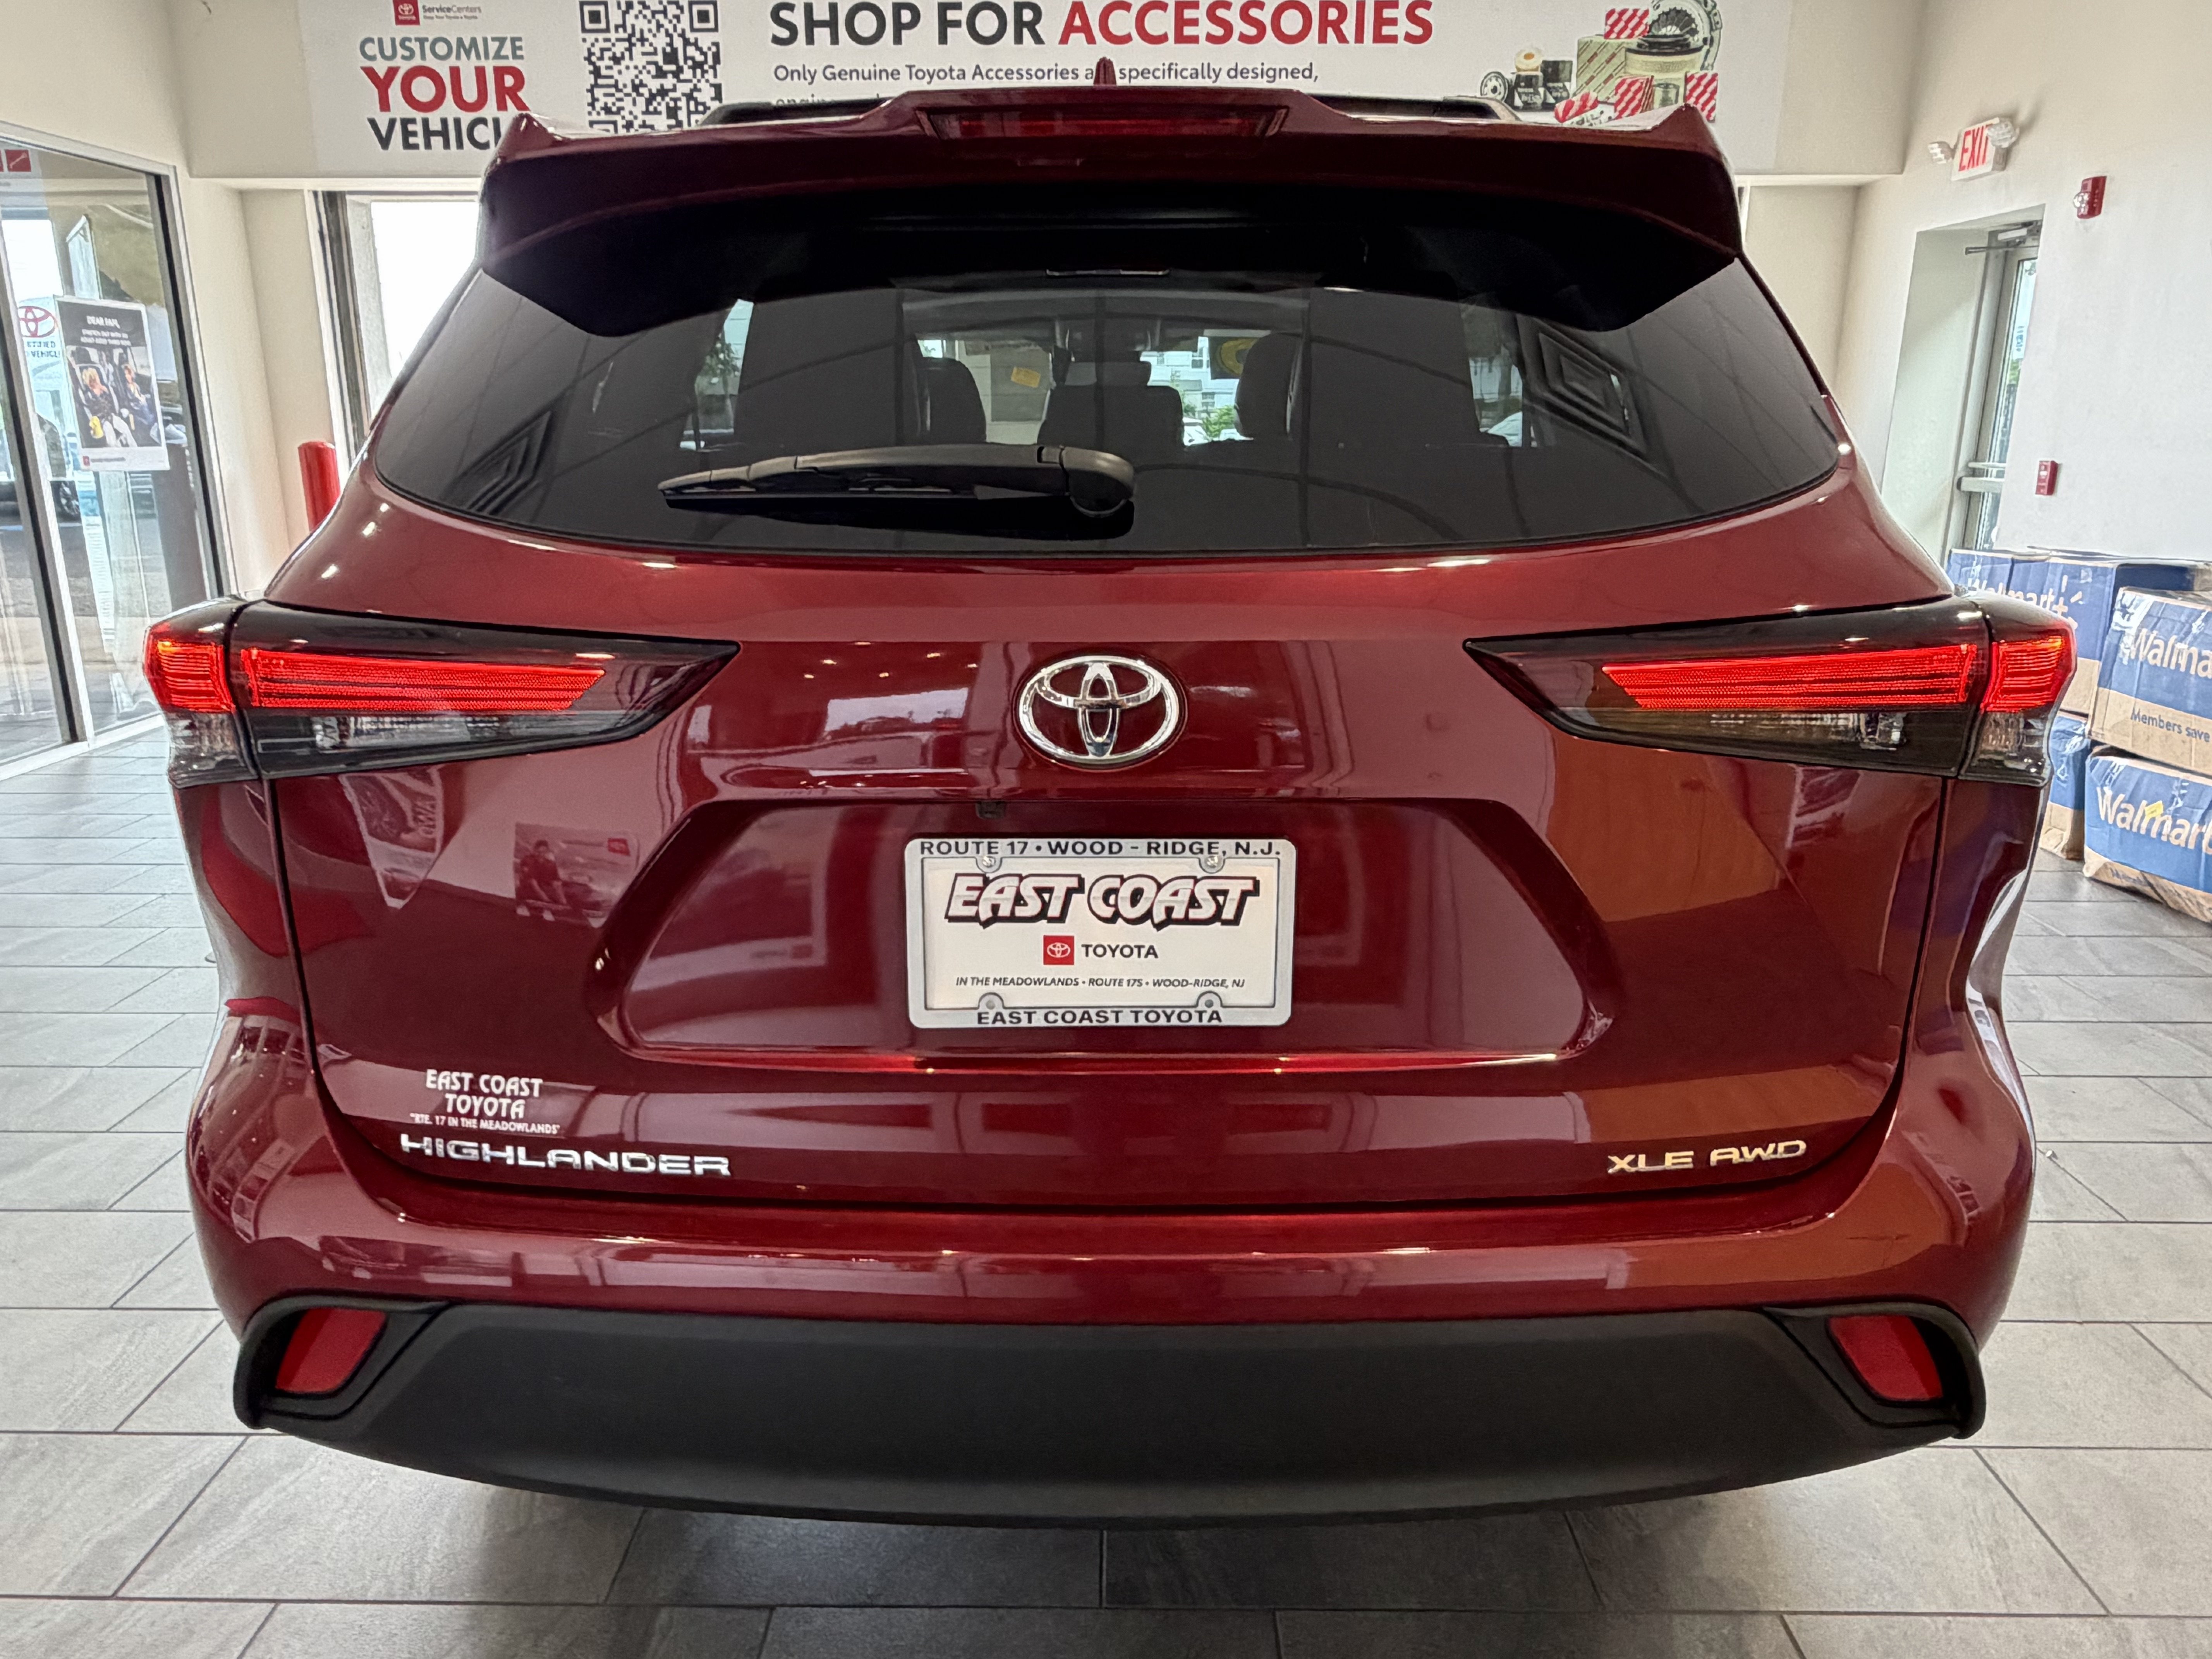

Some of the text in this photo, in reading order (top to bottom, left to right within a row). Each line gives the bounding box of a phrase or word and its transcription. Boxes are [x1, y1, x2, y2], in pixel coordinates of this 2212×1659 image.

[770, 0, 1432, 45] SHOP FOR ACCESSORIES
[359, 36, 524, 61] CUSTOMIZE
[774, 64, 817, 85] Only
[822, 64, 900, 81] Genuine
[905, 64, 966, 85] Toyota
[972, 64, 1079, 81] Accessories
[1118, 62, 1222, 84] specifically
[1226, 62, 1319, 84] designed,
[360, 65, 531, 113] YOUR
[367, 117, 501, 150] VEHICL
[1958, 123, 1993, 172] EXIT
[2131, 628, 2212, 679] Walma
[2131, 701, 2210, 743] Members save
[921, 841, 999, 855] ROUTE
[1007, 841, 1027, 855] 17
[1048, 841, 1123, 855] WOOD
[1147, 841, 1227, 857] RIDGE,
[1235, 841, 1281, 856] N.J.
[945, 872, 1260, 932] EAST COAST
[1082, 944, 1159, 959] TOYOTA
[956, 977, 969, 986] IN
[970, 977, 991, 986] THE
[993, 977, 1079, 987] MEADOWLANDS
[1088, 977, 1124, 988] ROUTE
[1152, 978, 1228, 989] WOOD-RIDGE,
[1231, 979, 1245, 988] NJ
[977, 1010, 1223, 1025] EAST COAST TOYOTA
[426, 1069, 543, 1097] EAST COAST
[445, 1093, 526, 1119] TOYOTA
[435, 1115, 446, 1126] 17
[448, 1117, 459, 1127] IN
[460, 1118, 477, 1128] THE
[400, 1133, 731, 1176] HIGHLANDER
[1607, 1139, 1807, 1174] XLE AWD
